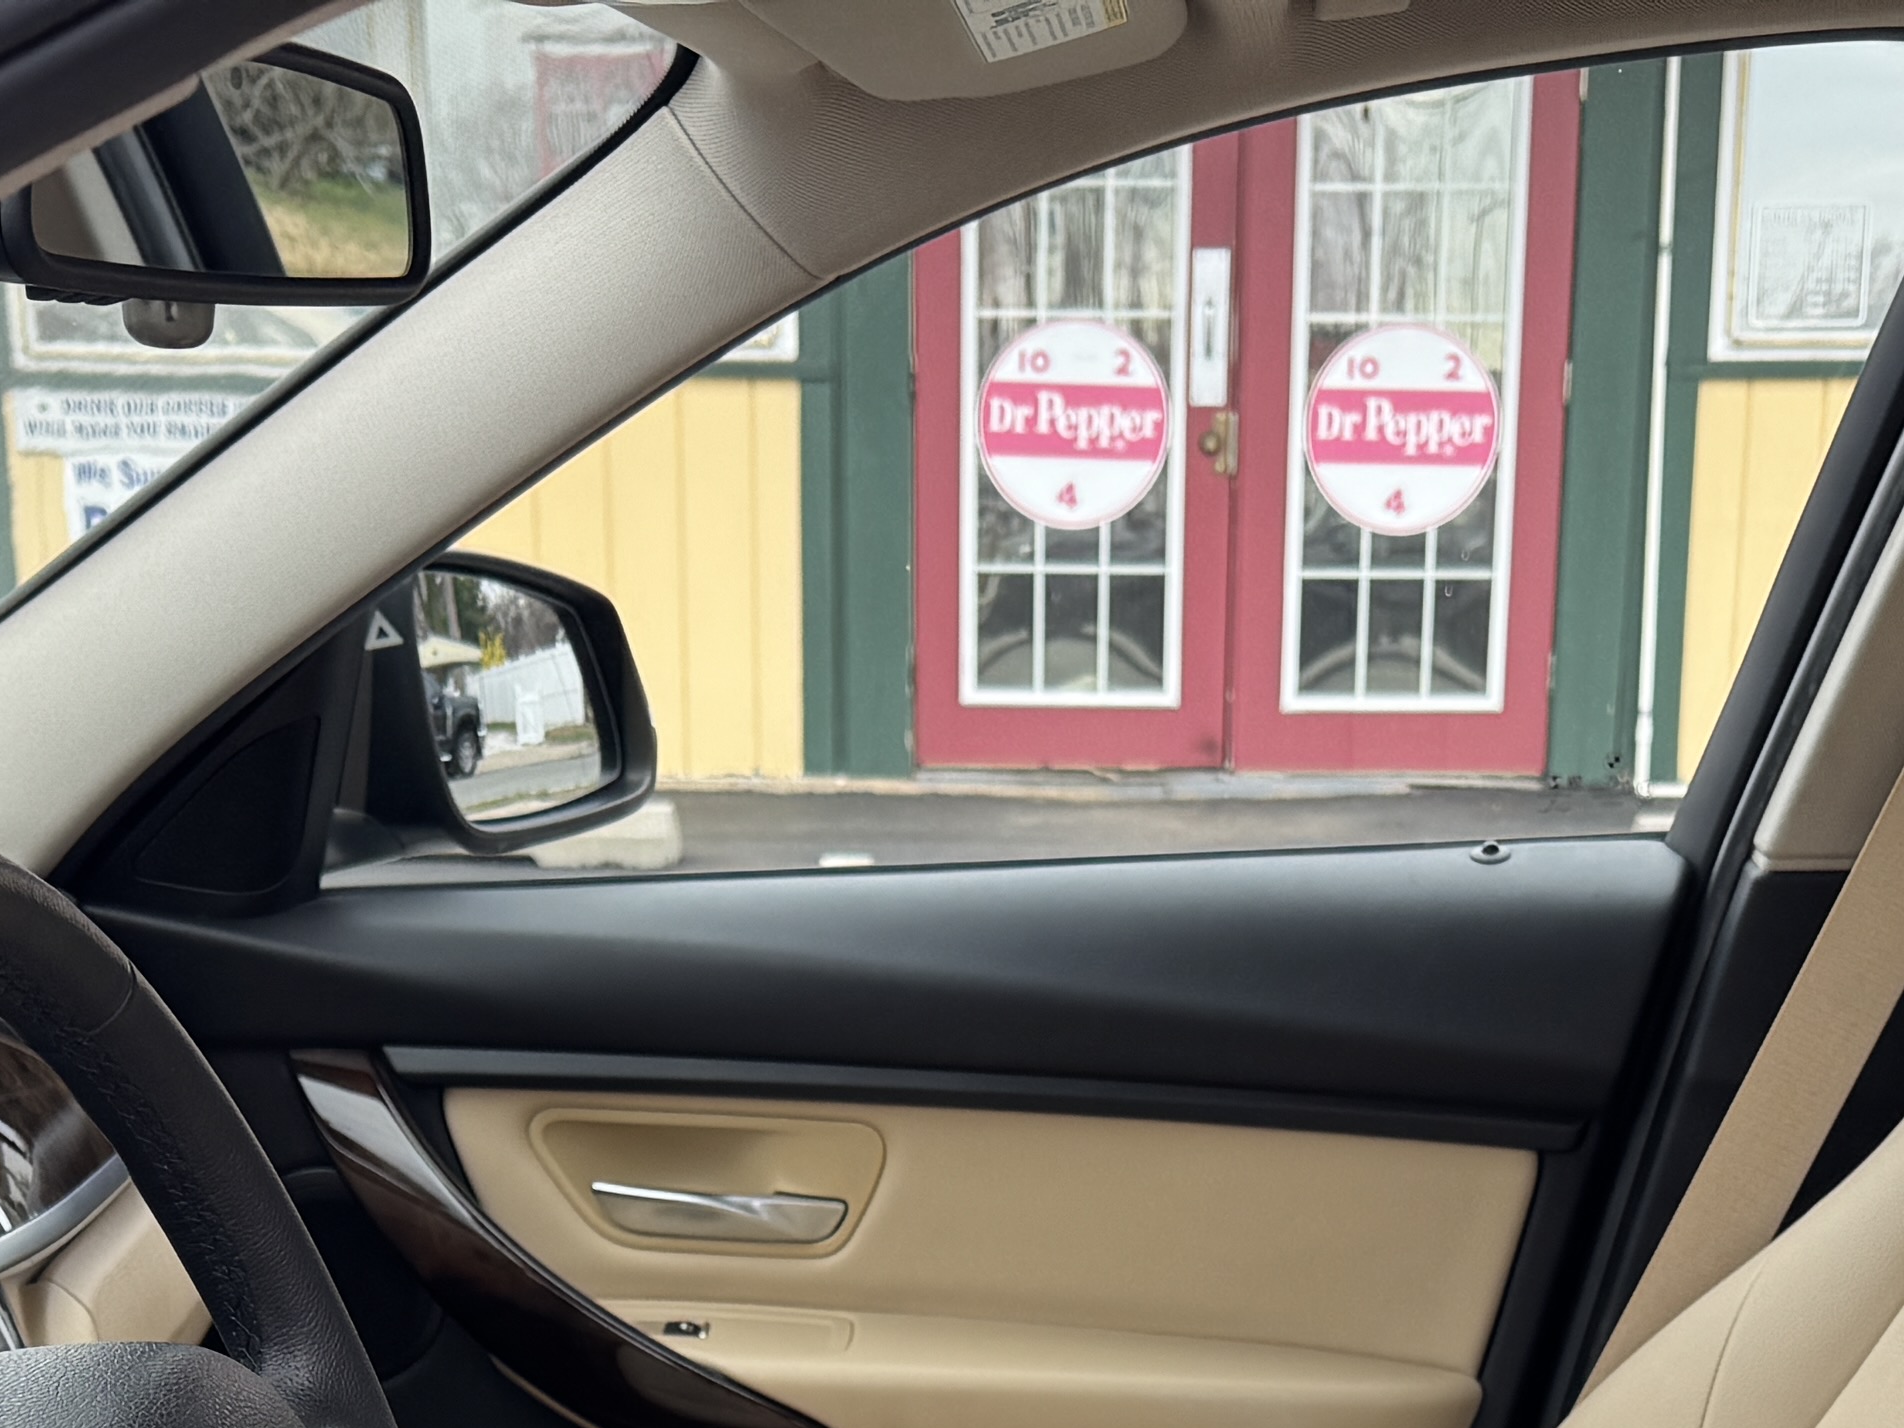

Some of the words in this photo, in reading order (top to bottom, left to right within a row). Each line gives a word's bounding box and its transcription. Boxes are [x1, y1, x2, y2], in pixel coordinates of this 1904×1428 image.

[1018, 349, 1051, 374] 10
[1114, 348, 1132, 377] 2
[1346, 355, 1380, 380] 10
[1443, 352, 1462, 381] 2
[988, 395, 1034, 434] Dr
[1035, 388, 1163, 450] Pepper
[1316, 403, 1362, 441] Dr
[1364, 395, 1493, 456] Pepper
[1056, 481, 1078, 510] 4
[1384, 487, 1406, 515] 4
